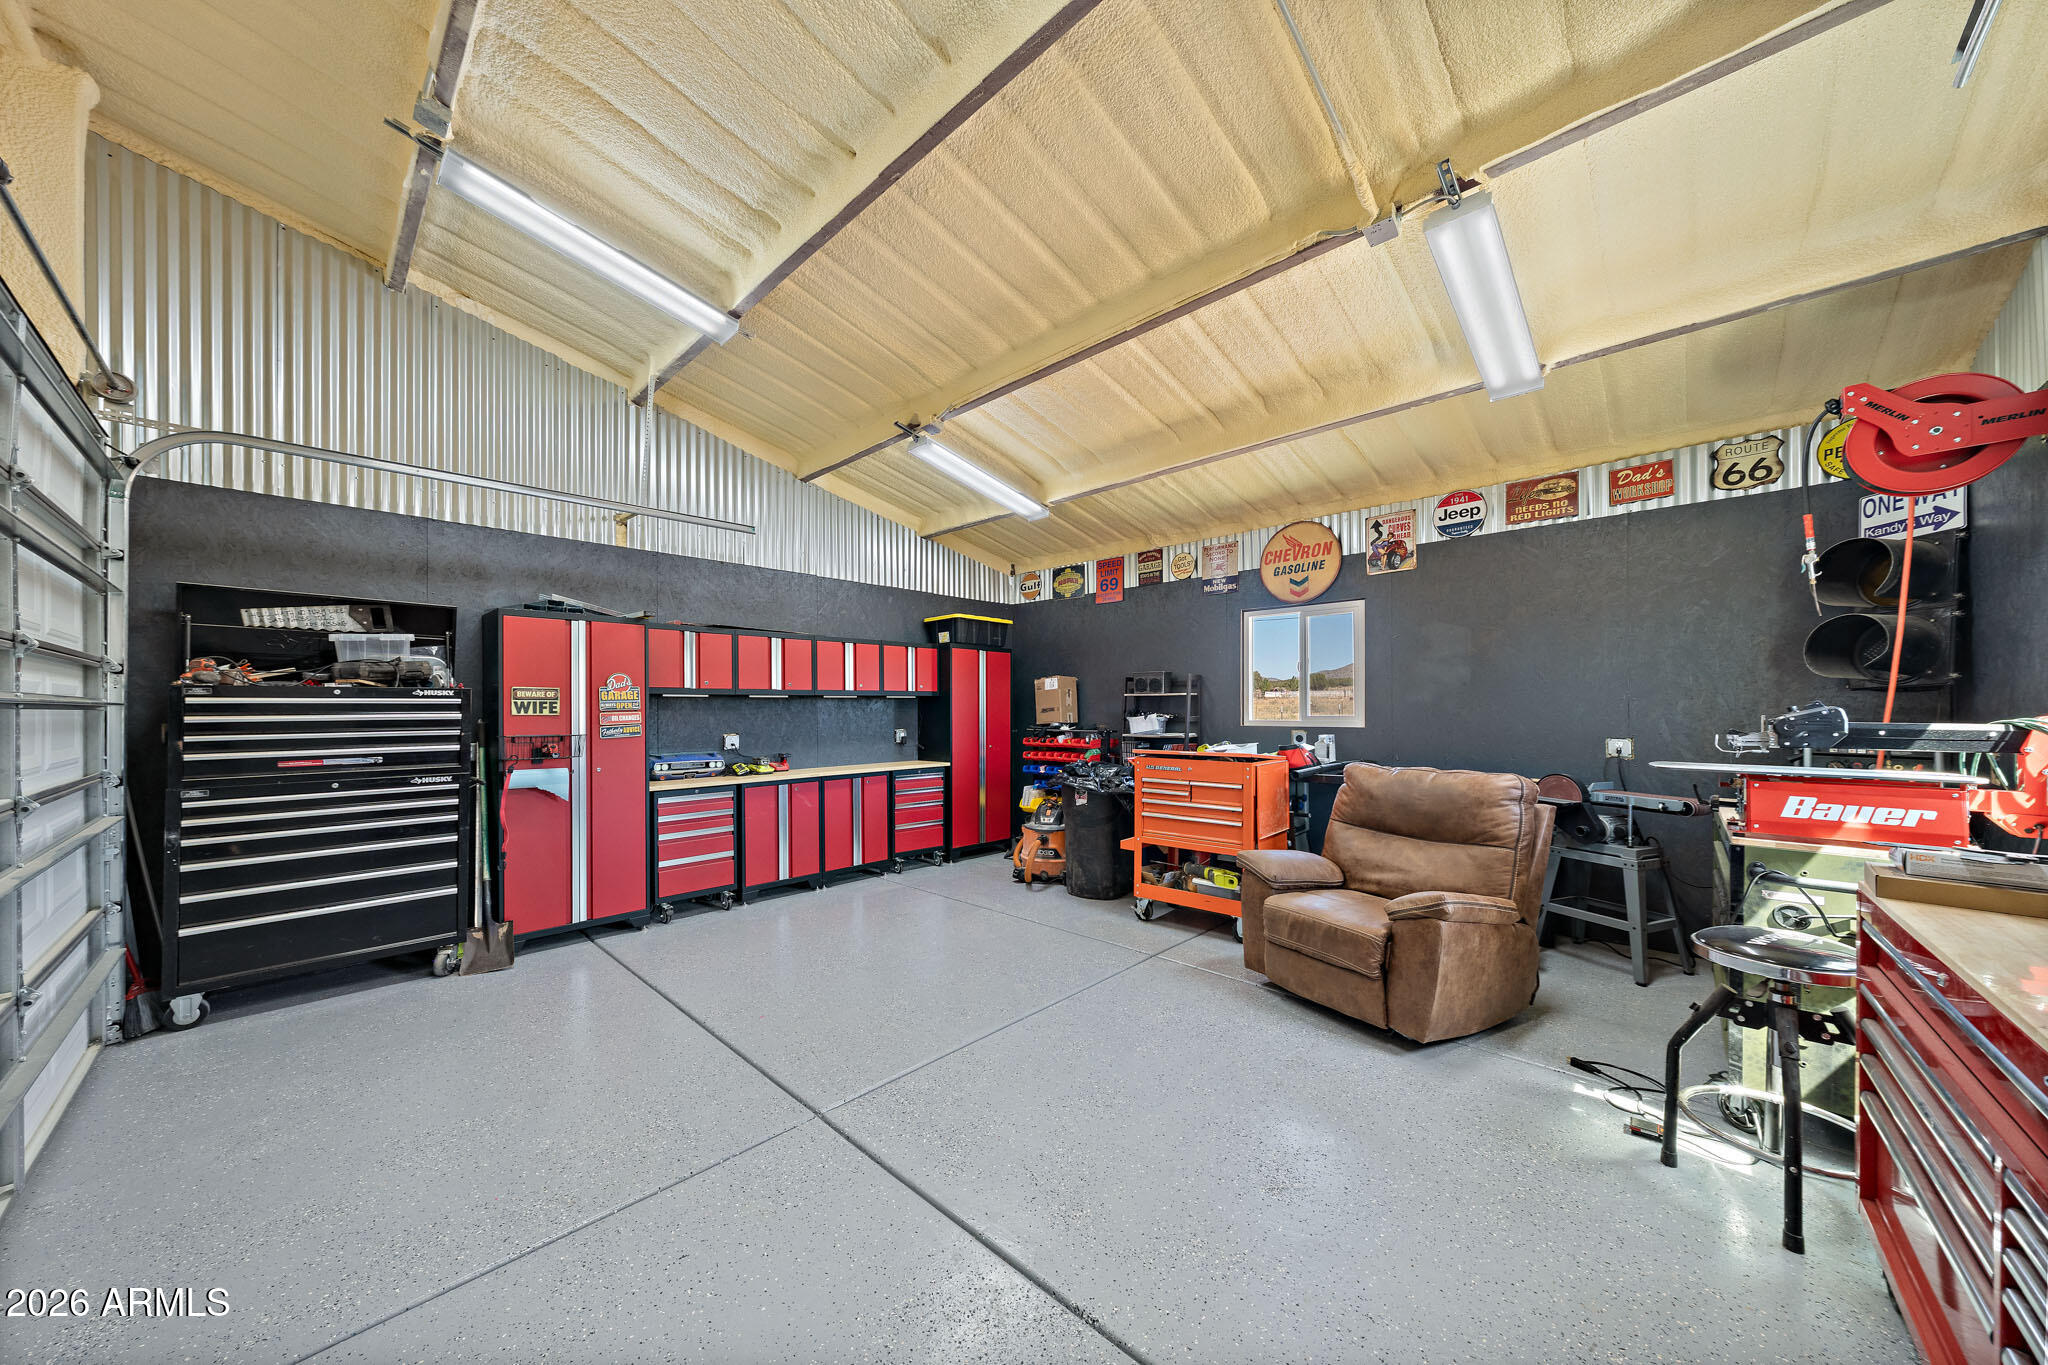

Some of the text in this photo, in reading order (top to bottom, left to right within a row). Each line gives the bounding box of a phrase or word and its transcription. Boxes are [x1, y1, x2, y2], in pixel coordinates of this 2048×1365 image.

[1864, 400, 1910, 421] MERLIN
[1981, 407, 2047, 425] MERLIN
[1725, 441, 1769, 456] ROUTE
[1824, 446, 1844, 461] PE
[1617, 464, 1666, 485] Dad's
[1722, 457, 1773, 486] 66
[1613, 478, 1673, 501] WORKSHOP
[1450, 495, 1469, 505] 1941
[1515, 499, 1569, 514] NEEDS NO
[1863, 493, 1906, 518] ONE
[1382, 515, 1412, 525] DANGEROUS
[1438, 506, 1481, 522] Jeep
[1510, 506, 1574, 521] RED LIGHTS
[1387, 522, 1411, 533] CURVES
[1865, 510, 1951, 538] Kandy' Way
[1393, 531, 1411, 540] AHEAD
[1203, 543, 1237, 552] PERFORMANCE
[1264, 540, 1333, 566] CHEVRON
[1098, 560, 1122, 569] SPEED
[1173, 560, 1194, 570] TOOLS?
[1273, 559, 1326, 577] GASOLINE
[1100, 568, 1119, 577] LIMIT
[1020, 581, 1041, 592] Gulf
[1100, 577, 1119, 592] 69
[1203, 583, 1237, 593] Mobilgas
[607, 677, 632, 690] Dad's
[601, 691, 639, 701] GARAGE
[513, 701, 558, 714] WIFE
[422, 775, 453, 783] HUSKY
[1780, 795, 1938, 827] Bauer
